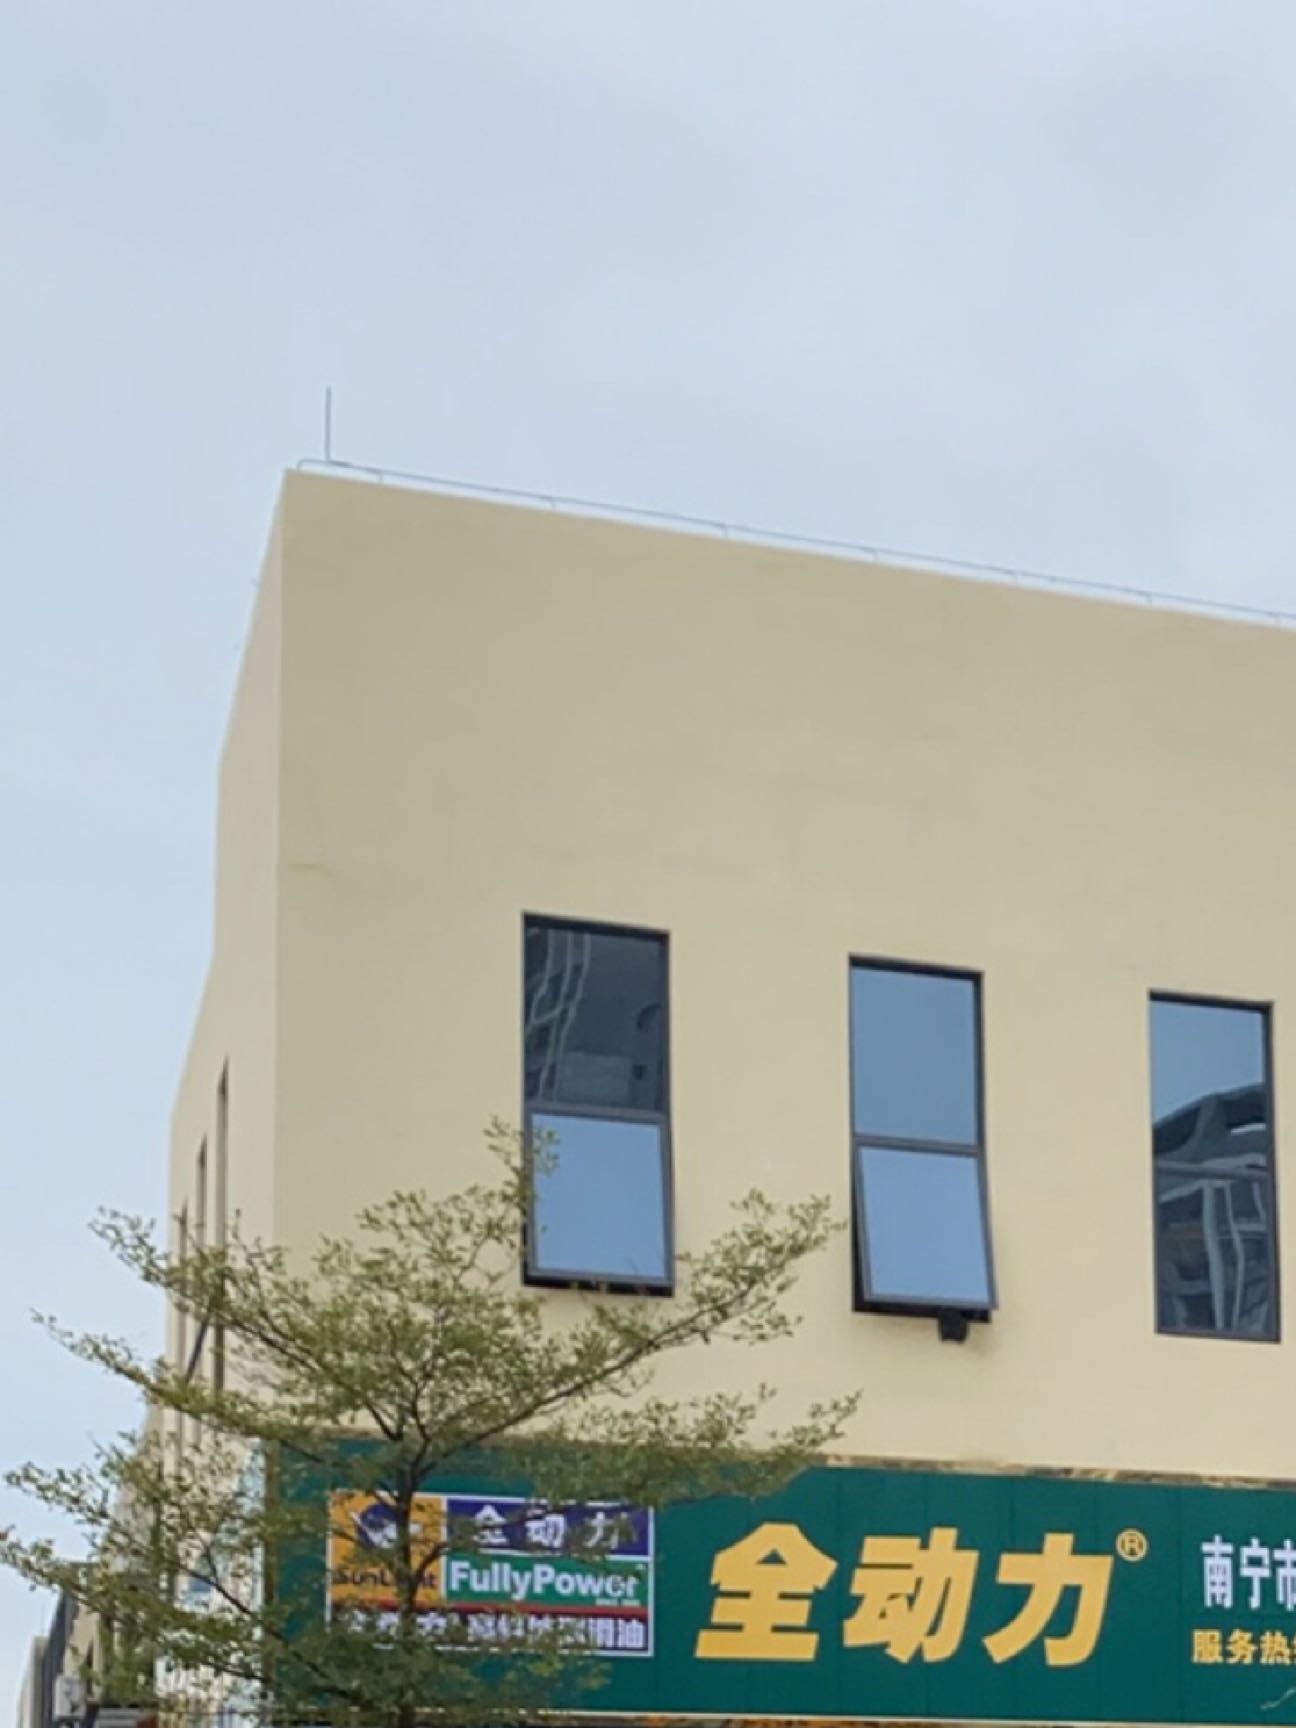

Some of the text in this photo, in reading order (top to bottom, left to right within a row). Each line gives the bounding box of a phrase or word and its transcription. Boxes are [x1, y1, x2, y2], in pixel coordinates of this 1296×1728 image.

[450, 1560, 640, 1601] FullyPower
[694, 1522, 1114, 1666] 全动力
